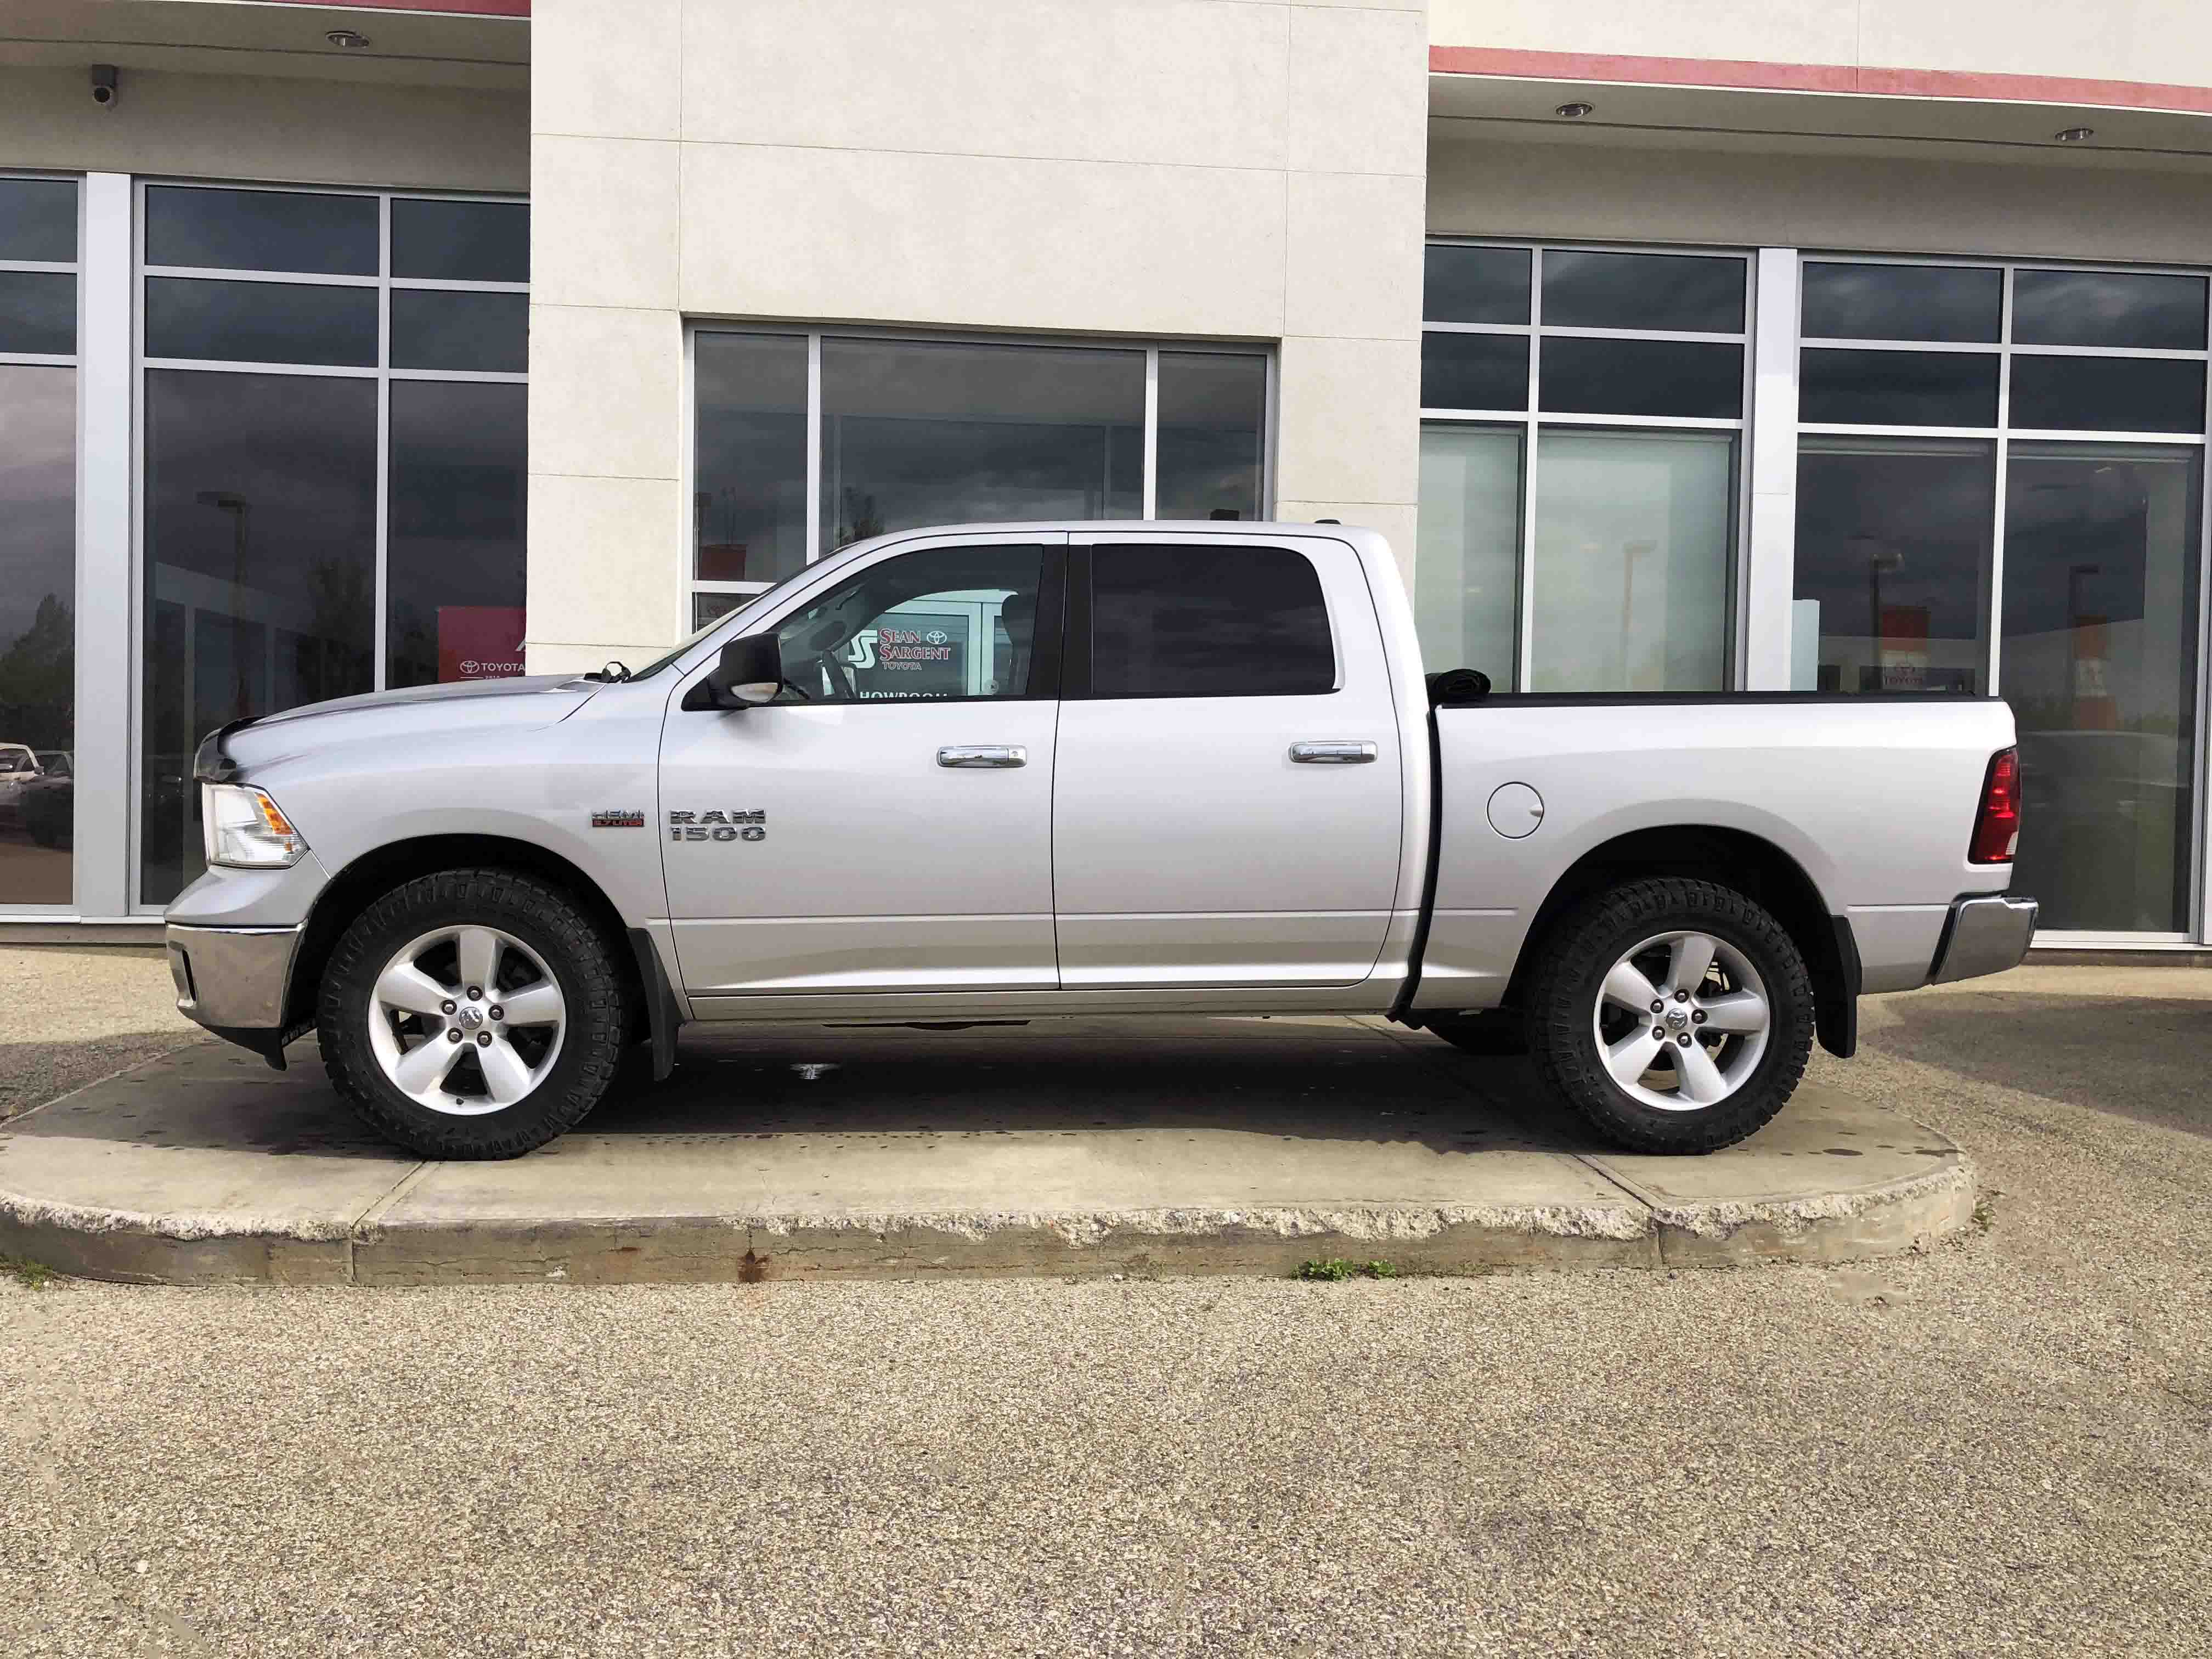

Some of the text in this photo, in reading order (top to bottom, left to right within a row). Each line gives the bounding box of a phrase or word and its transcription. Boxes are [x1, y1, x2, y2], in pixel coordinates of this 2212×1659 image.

[481, 663, 526, 672] TOYOTA
[882, 662, 922, 670] TOYOTA
[670, 809, 766, 824] RAM
[670, 826, 766, 841] 1500
